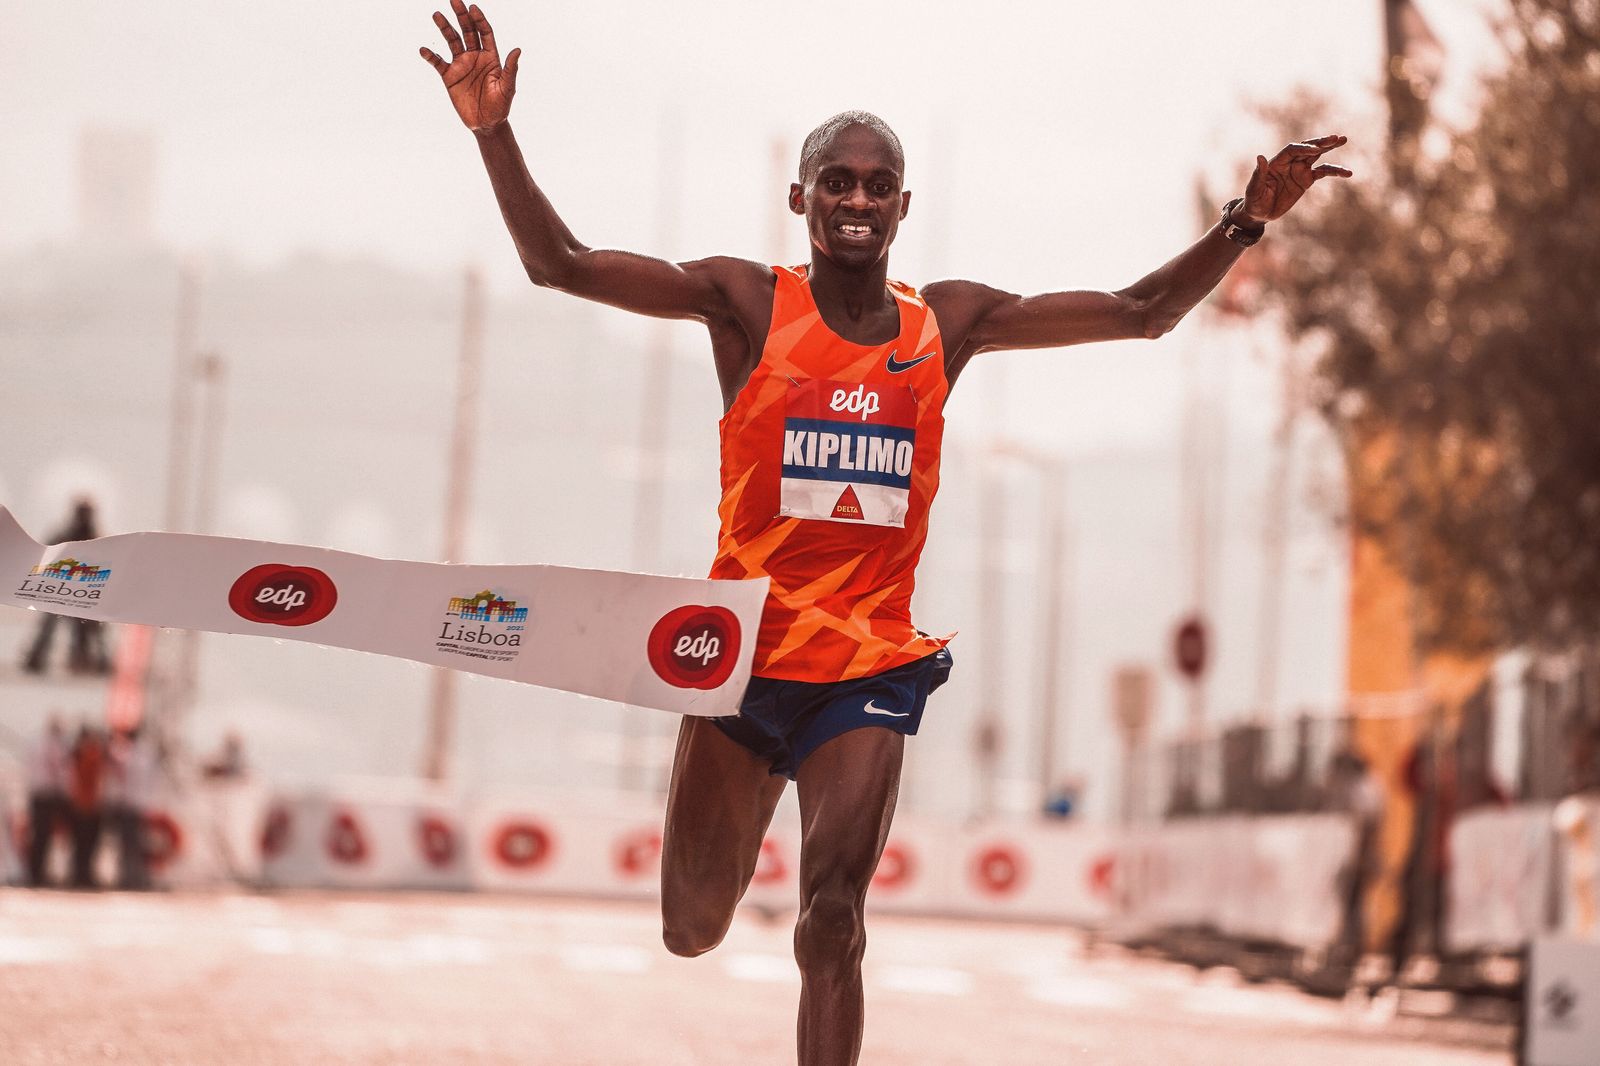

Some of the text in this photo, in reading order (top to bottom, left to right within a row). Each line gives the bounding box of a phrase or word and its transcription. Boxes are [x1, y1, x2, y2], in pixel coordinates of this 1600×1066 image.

[829, 384, 880, 421] edp
[783, 430, 914, 477] KIPLIMO
[836, 505, 859, 513] DELTA
[18, 580, 101, 599] Lisboa
[255, 584, 306, 611] edp
[439, 622, 520, 646] Lisboa
[673, 630, 720, 665] edp
